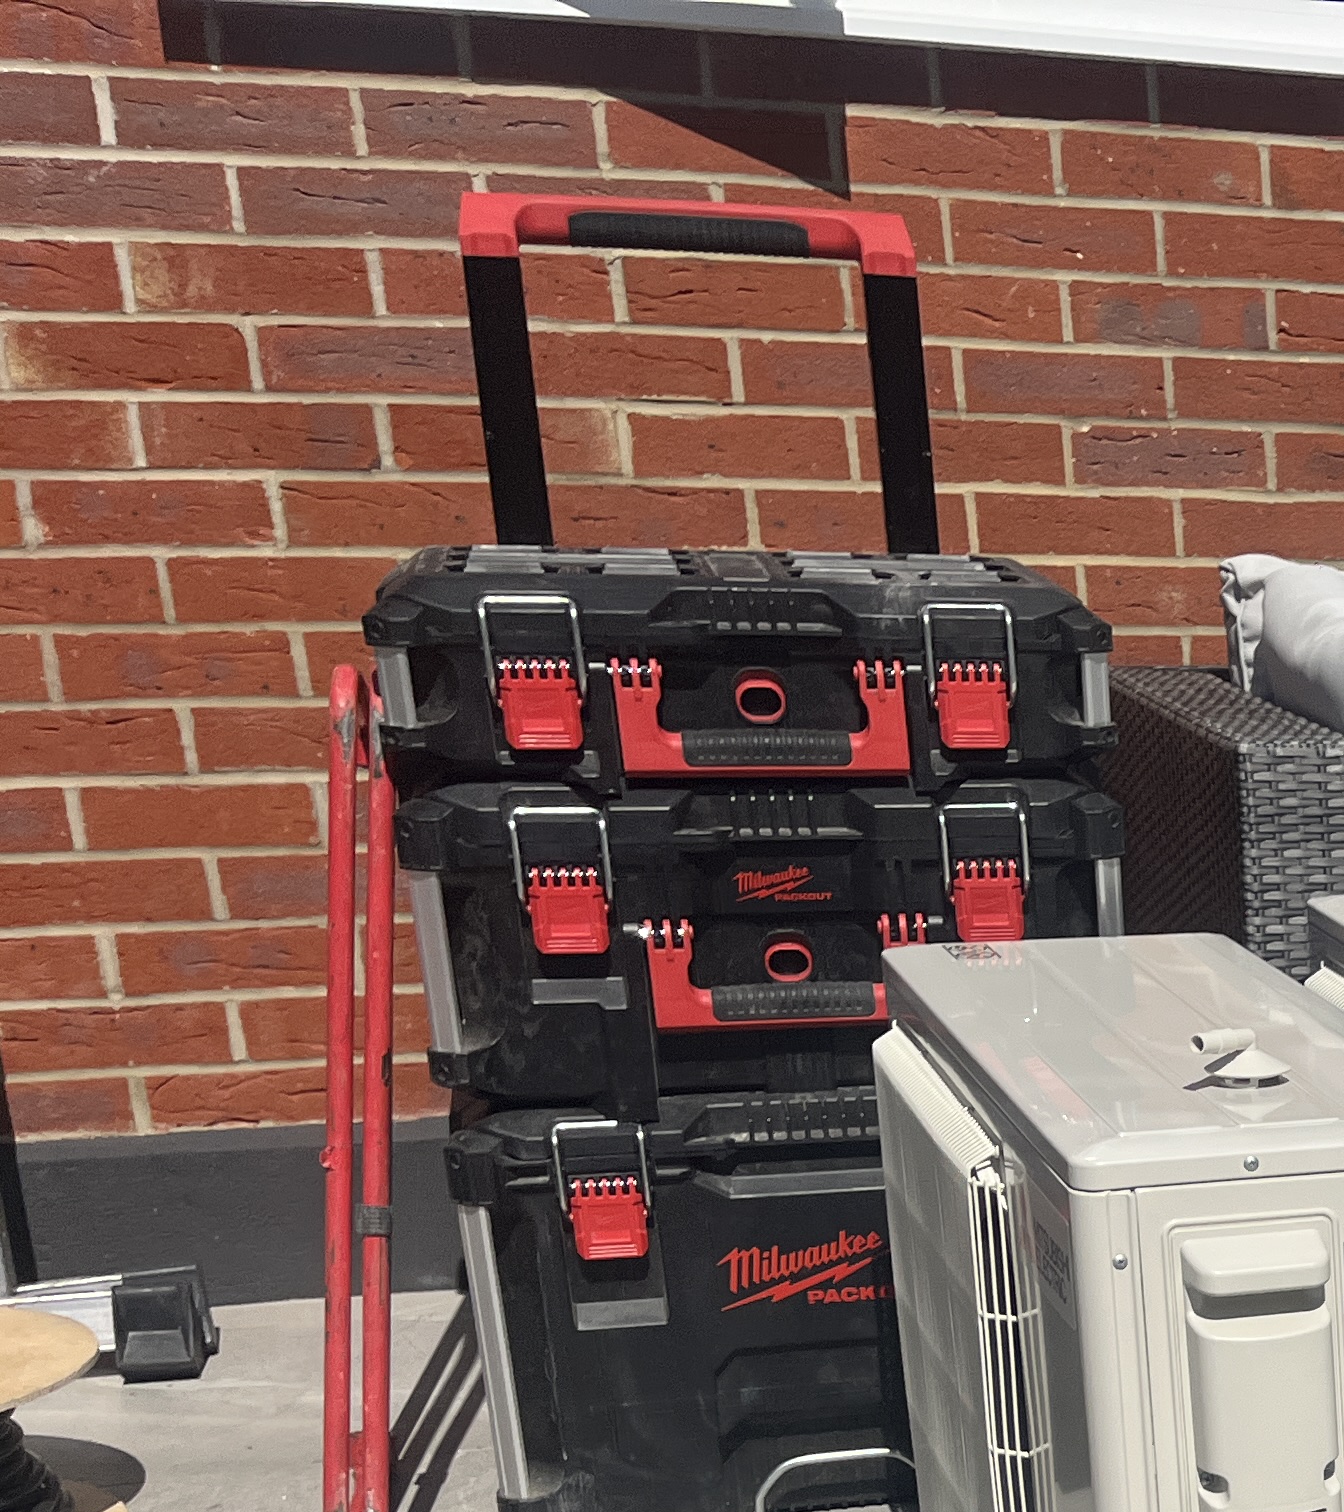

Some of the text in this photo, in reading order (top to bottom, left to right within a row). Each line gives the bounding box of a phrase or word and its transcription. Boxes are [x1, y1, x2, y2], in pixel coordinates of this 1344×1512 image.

[733, 864, 809, 894] Milwaukee
[775, 892, 832, 902] PACKOUT
[716, 1230, 884, 1294] Milwaukee
